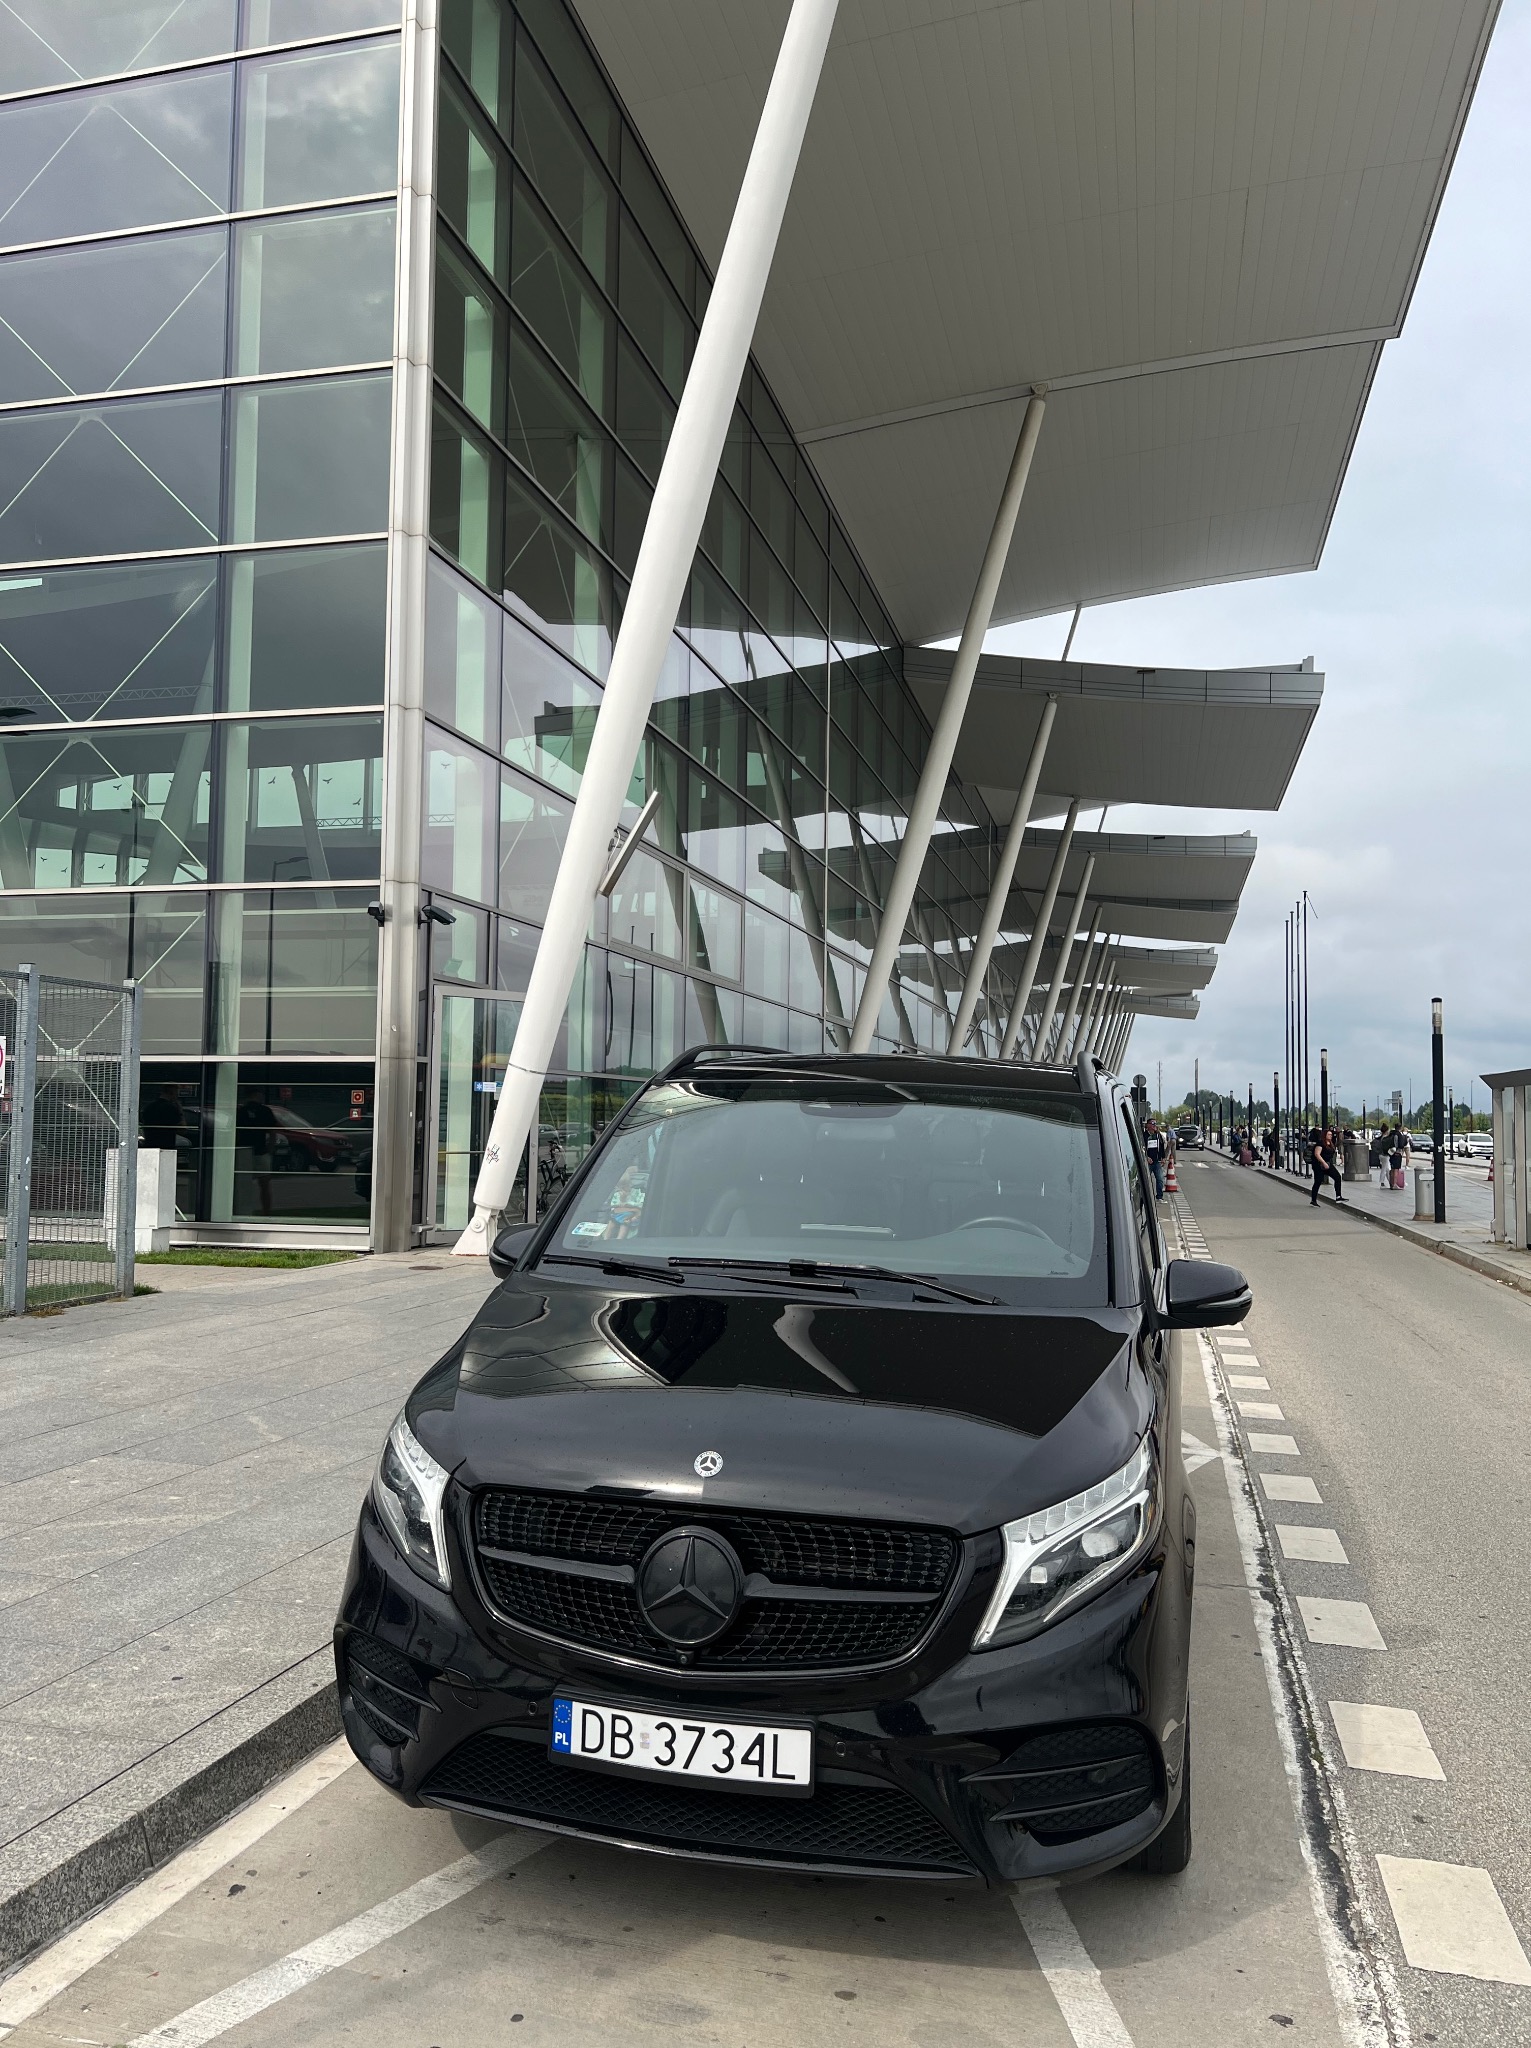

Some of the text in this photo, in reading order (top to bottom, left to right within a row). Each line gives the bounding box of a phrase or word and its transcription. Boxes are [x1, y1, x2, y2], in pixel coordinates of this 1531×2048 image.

[554, 1731, 569, 1746] PL
[581, 1708, 796, 1780] DB 3734L
